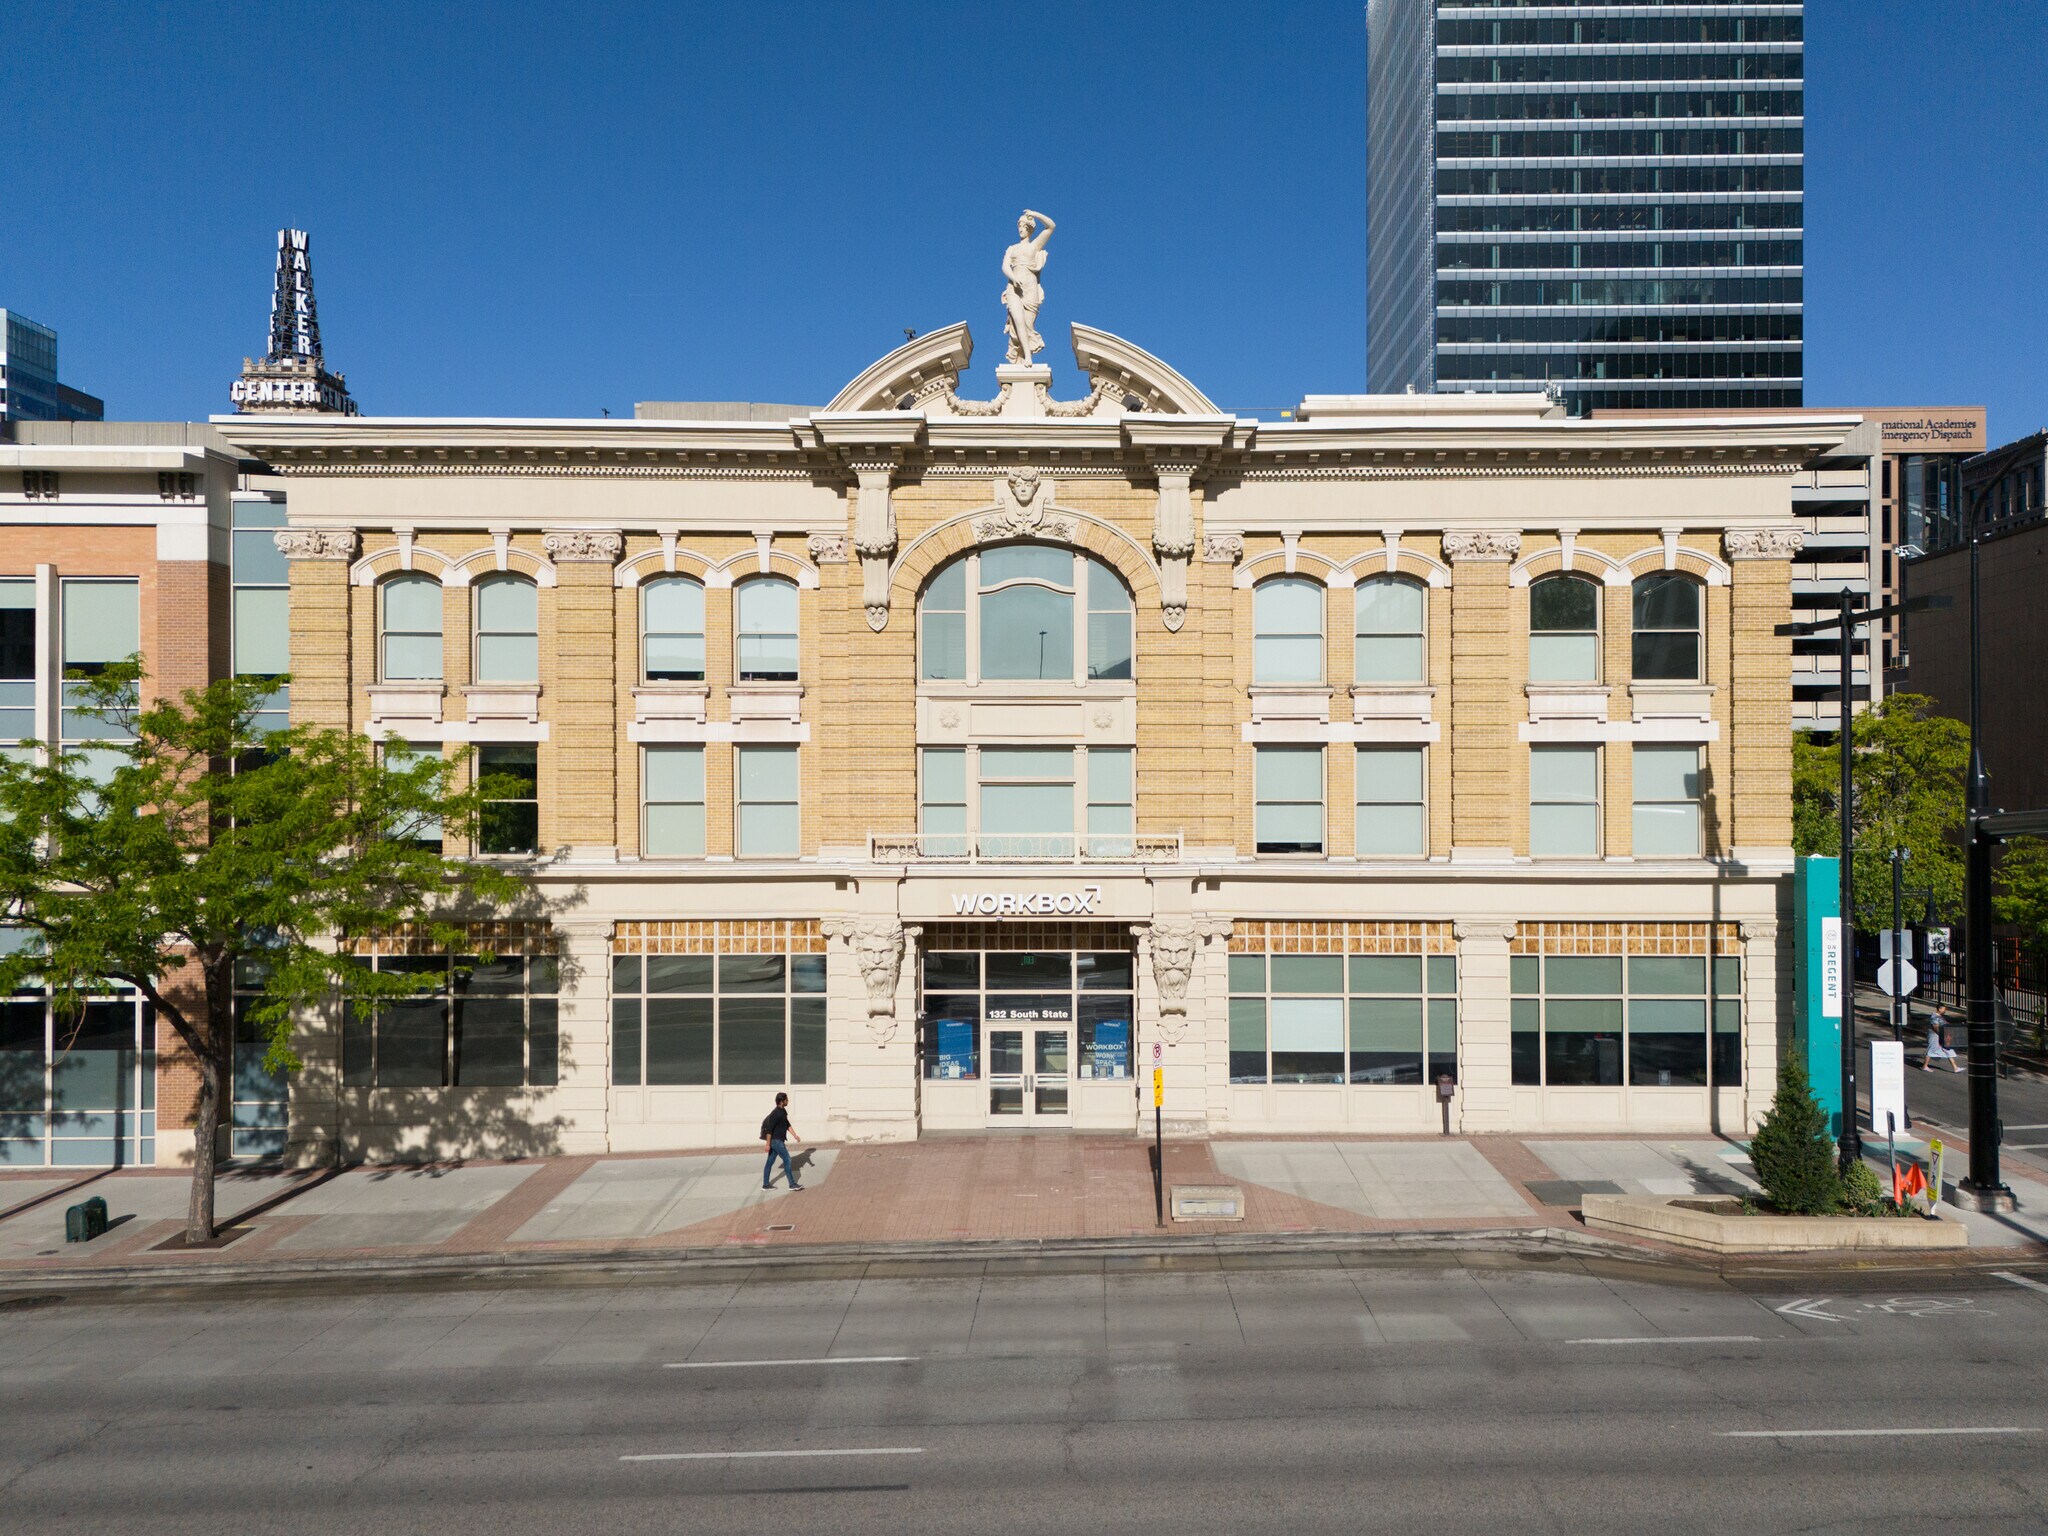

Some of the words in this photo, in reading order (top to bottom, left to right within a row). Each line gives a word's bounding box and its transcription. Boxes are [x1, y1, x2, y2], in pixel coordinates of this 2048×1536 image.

[290, 229, 311, 355] WALKER
[231, 381, 317, 402] CENTER
[1925, 419, 1976, 429] Academies
[1931, 429, 1972, 441] Dispatch
[951, 893, 1095, 914] WORKBOX
[1933, 942, 1946, 951] 10
[1828, 952, 1837, 998] REGENT
[989, 1010, 1006, 1018] 132
[1010, 1010, 1038, 1018] South
[1042, 1010, 1068, 1018] State
